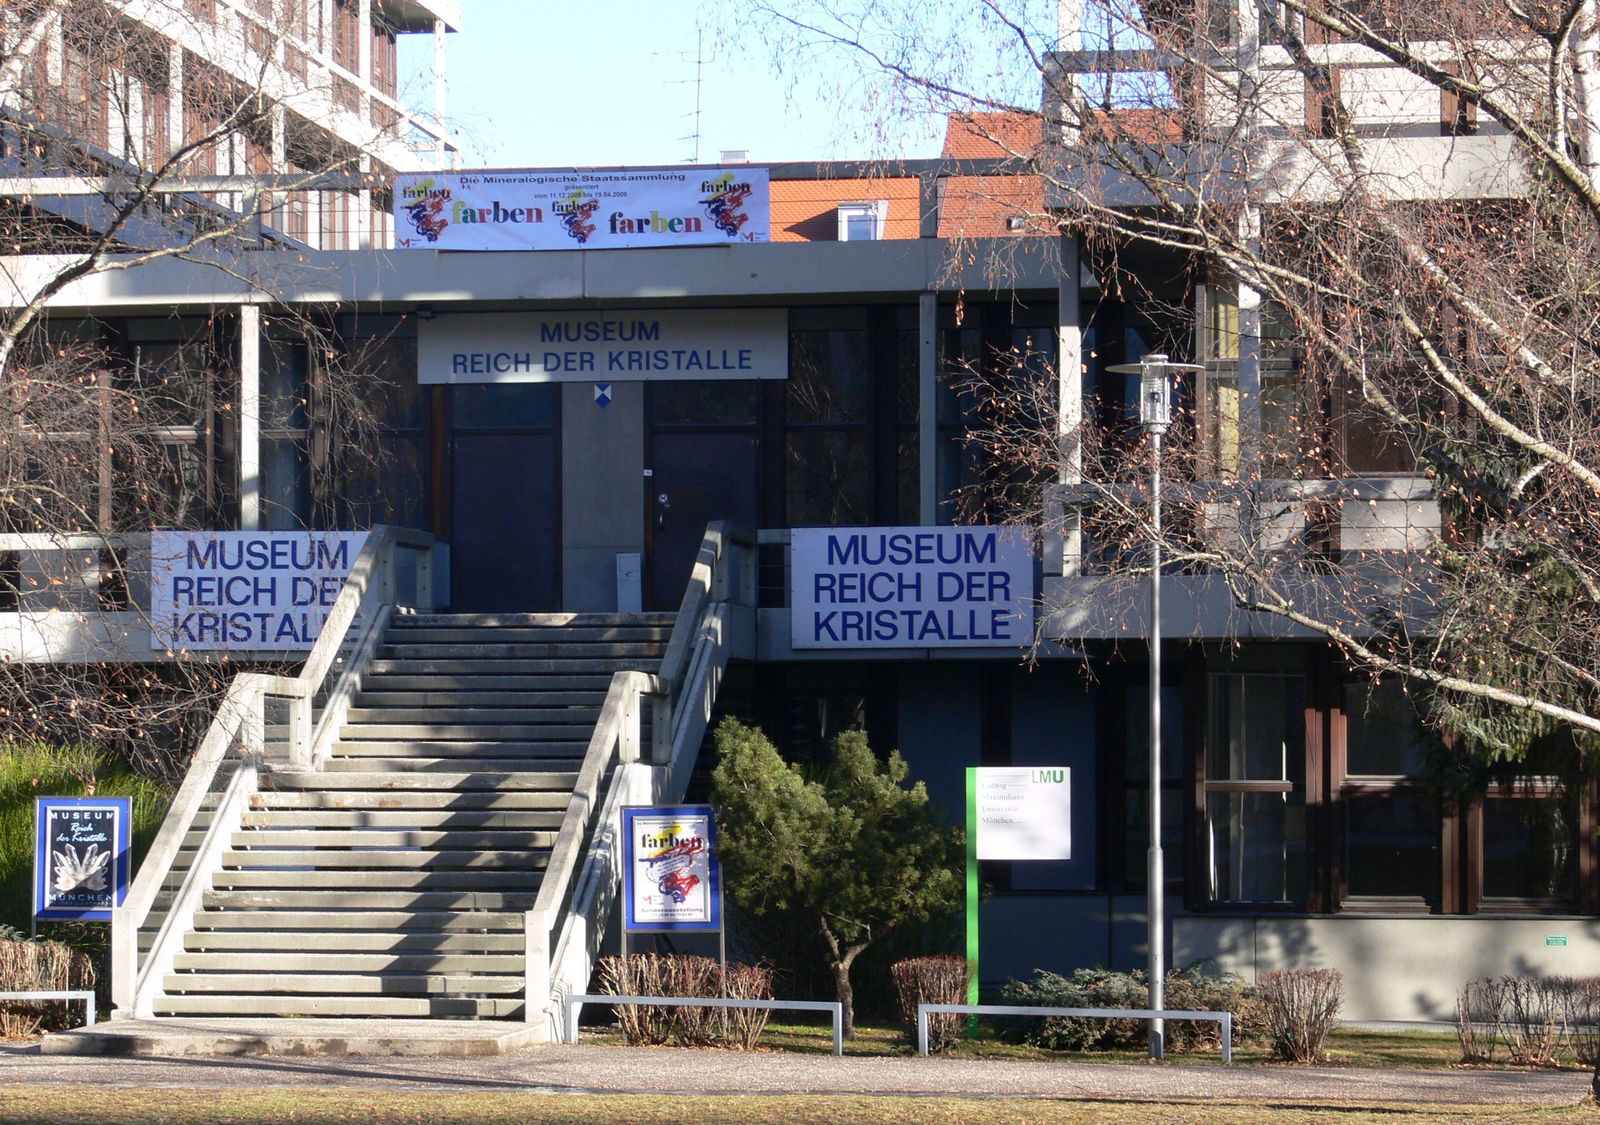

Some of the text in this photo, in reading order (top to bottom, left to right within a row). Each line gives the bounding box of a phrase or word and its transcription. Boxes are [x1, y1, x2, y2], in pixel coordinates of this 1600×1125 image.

[460, 173, 686, 184] Die Mineralogische Staatssammlung
[701, 180, 751, 193] farben
[402, 186, 450, 199] farben
[452, 201, 543, 224] farben
[552, 200, 599, 213] farben
[608, 210, 703, 234] farben
[540, 320, 660, 343] MUSEUM
[452, 349, 753, 374] REICH DER KRISTALLE
[187, 540, 348, 570] MUSEUM
[828, 533, 996, 565] MUSEUM
[173, 576, 348, 606] REICH DE
[814, 571, 1010, 603] REICH DER
[814, 609, 1011, 641] KRISTALLE
[1032, 769, 1064, 784] LMU
[51, 811, 114, 820] MUSEUM
[641, 832, 703, 849] farben
